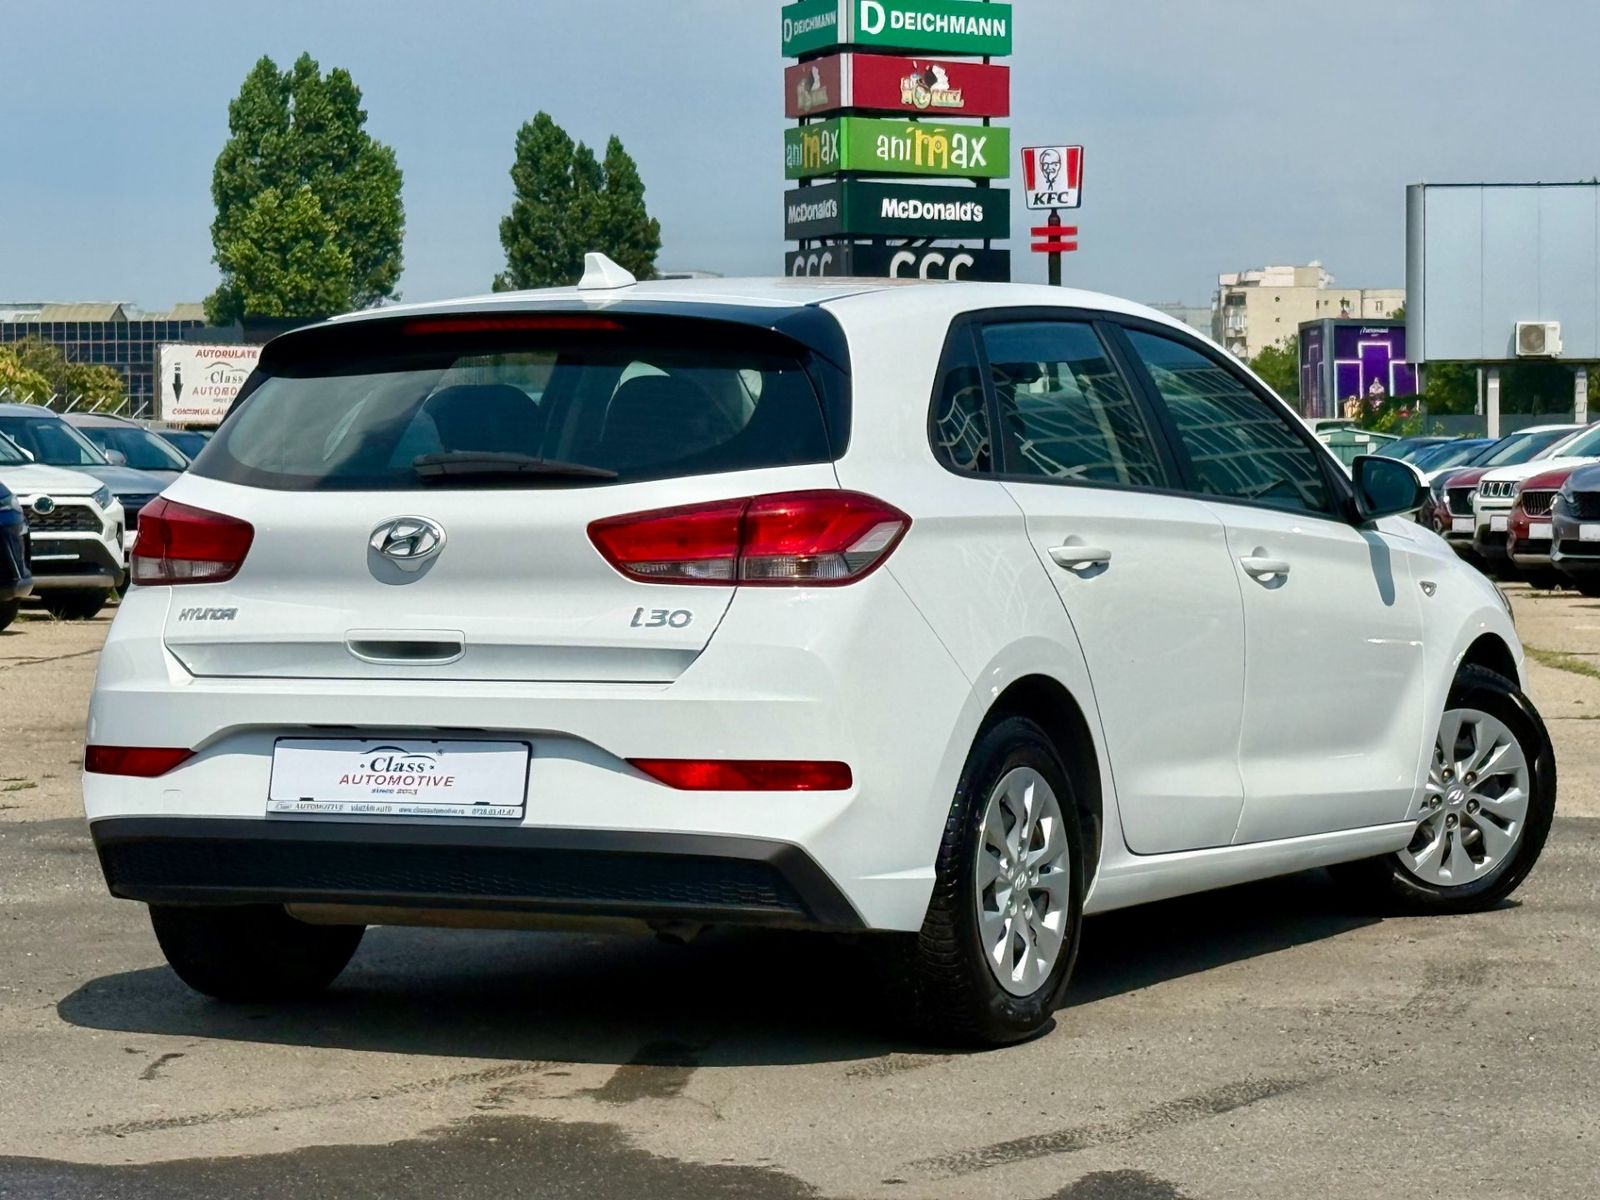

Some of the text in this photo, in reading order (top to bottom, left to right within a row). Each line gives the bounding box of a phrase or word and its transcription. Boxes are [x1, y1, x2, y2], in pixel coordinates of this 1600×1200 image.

[794, 10, 836, 36] DEICHMANN
[890, 10, 1006, 37] DEICHMANN
[876, 127, 987, 169] animax
[1033, 191, 1069, 206] KFC
[788, 199, 838, 223] McDonald's
[881, 198, 983, 222] McDonald's
[195, 349, 258, 359] AUTORULATE
[210, 370, 244, 384] Class
[178, 607, 238, 621] HYUNDAI
[630, 607, 694, 628] i30
[370, 756, 425, 773] Class
[339, 774, 456, 787] AUTOMOTIVE
